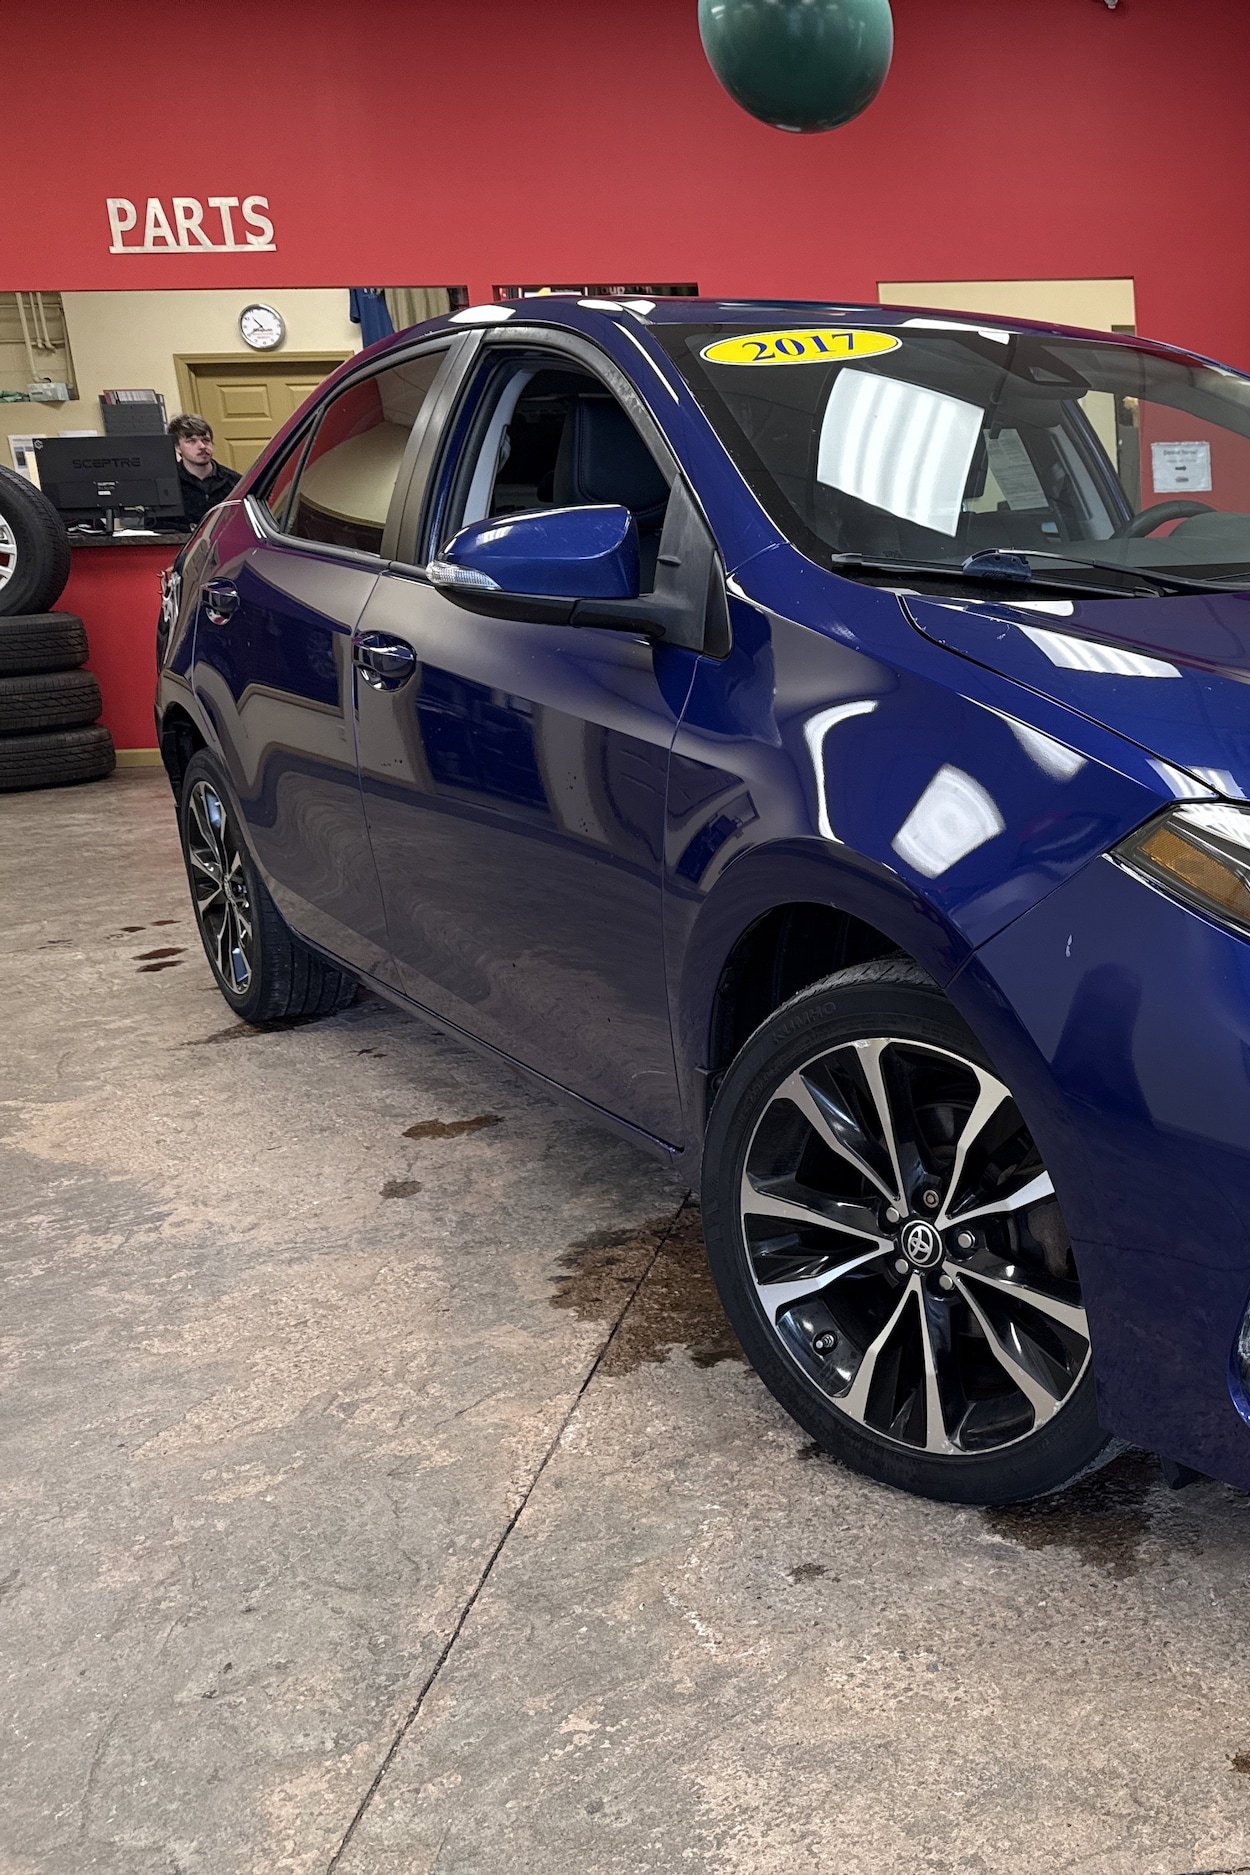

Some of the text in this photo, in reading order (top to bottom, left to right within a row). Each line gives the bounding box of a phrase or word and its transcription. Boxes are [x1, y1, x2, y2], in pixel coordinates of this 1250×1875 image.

[106, 195, 275, 248] PARTS
[742, 332, 855, 361] 2017
[72, 457, 141, 469] SCEPTRE
